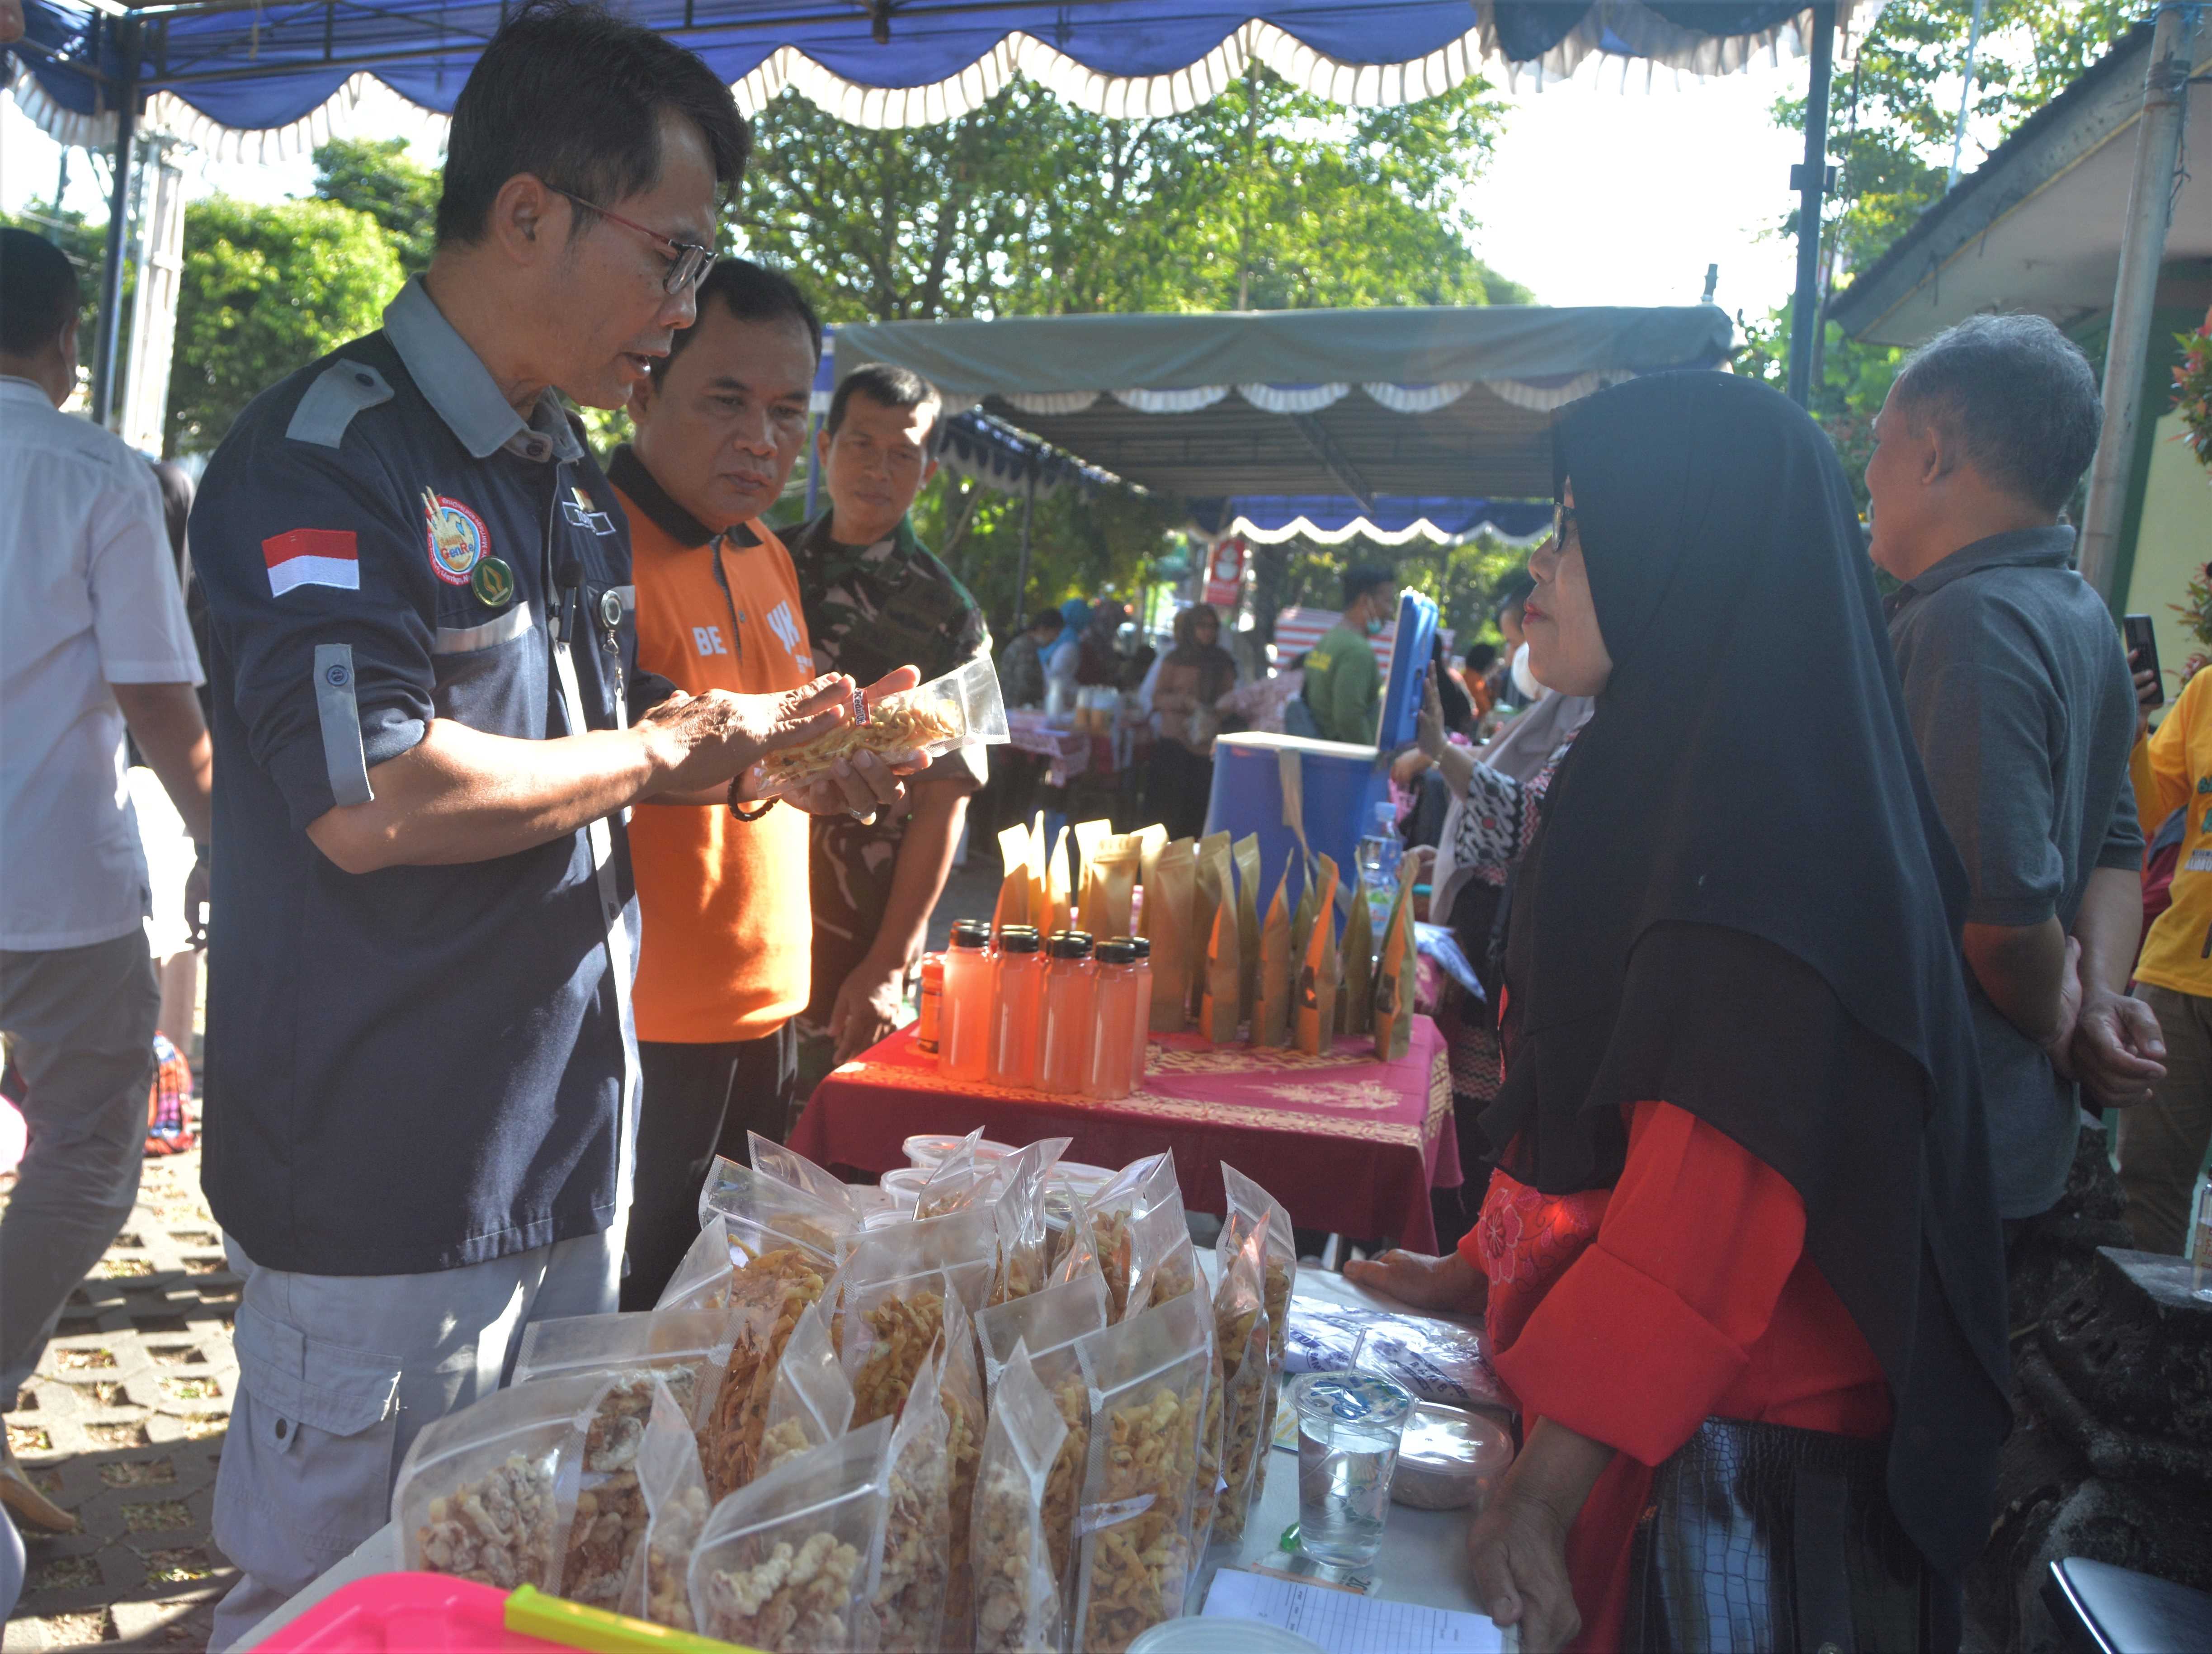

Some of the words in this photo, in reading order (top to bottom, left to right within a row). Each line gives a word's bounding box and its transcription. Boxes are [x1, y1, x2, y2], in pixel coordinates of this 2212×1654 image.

[441, 543, 474, 560] GenRe
[692, 626, 727, 656] BE
[854, 691, 864, 714] Kedai
